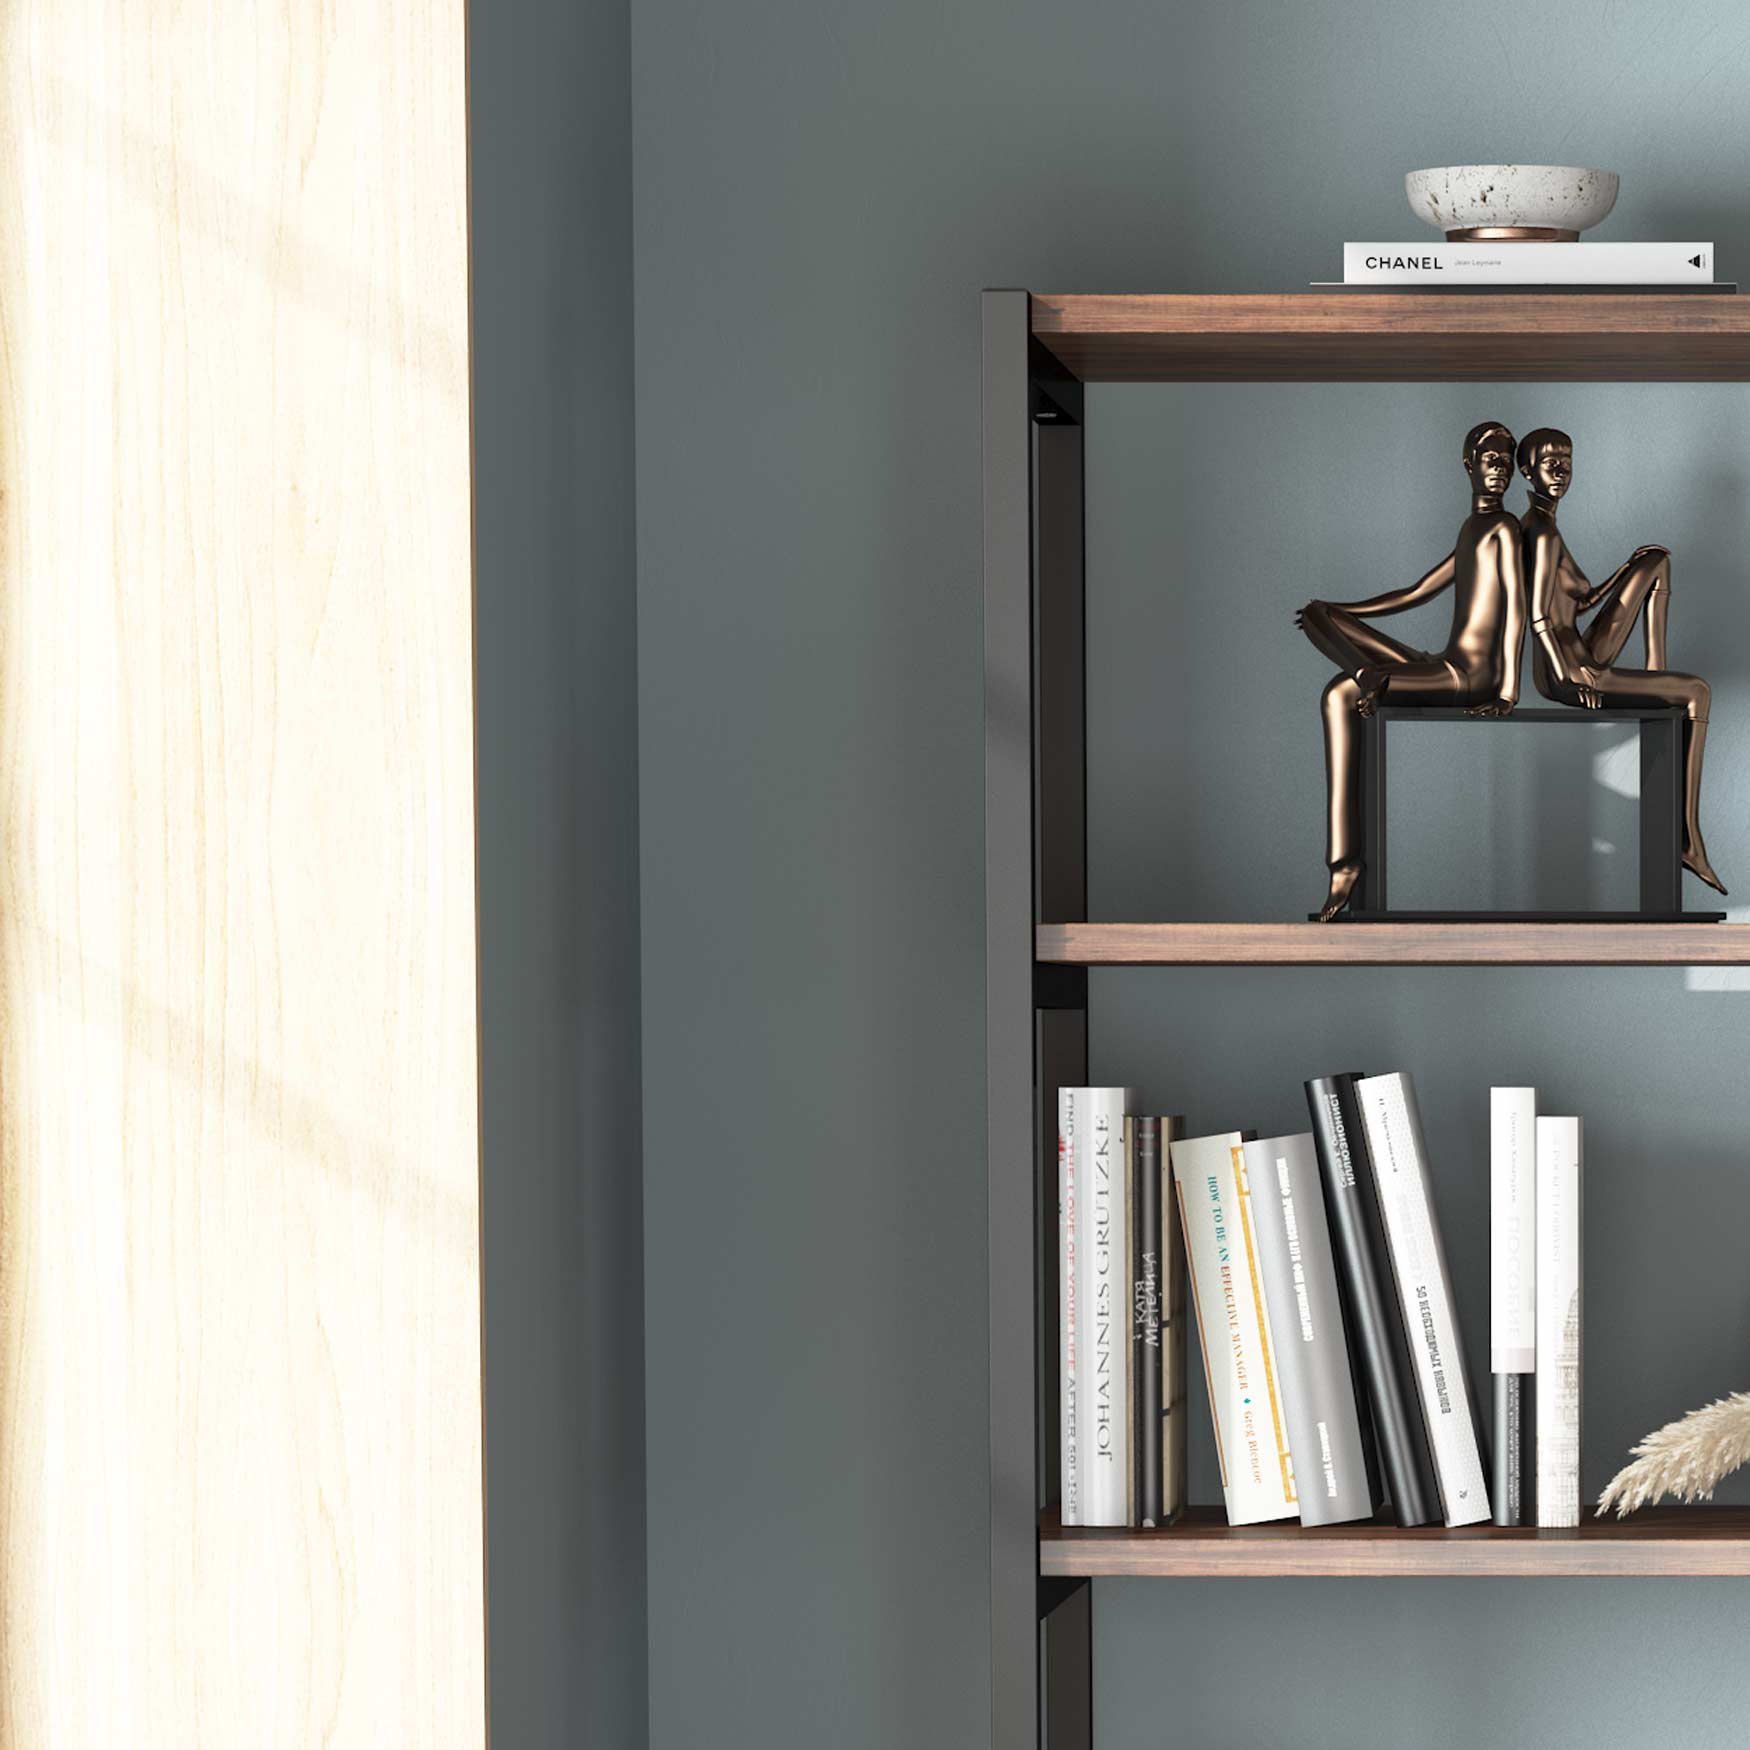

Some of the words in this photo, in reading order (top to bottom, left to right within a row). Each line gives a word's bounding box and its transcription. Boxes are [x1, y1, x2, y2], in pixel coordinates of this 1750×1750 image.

[1365, 256, 1444, 270] CHANEL
[1328, 1093, 1356, 1187] ИЛЛЮЗИОНИСТ
[1206, 1175, 1220, 1203] HOW
[1211, 1206, 1224, 1223] TO
[1215, 1226, 1228, 1242] BE
[1218, 1246, 1231, 1263] AN
[1134, 1279, 1147, 1324] КАТЯ
[1220, 1265, 1239, 1330] EFFECTIVE
[1416, 1285, 1428, 1299] 50
[1096, 1282, 1113, 1462] JOHANNES
[1230, 1332, 1249, 1391] MANAGER
[1242, 1410, 1255, 1438] Greg
